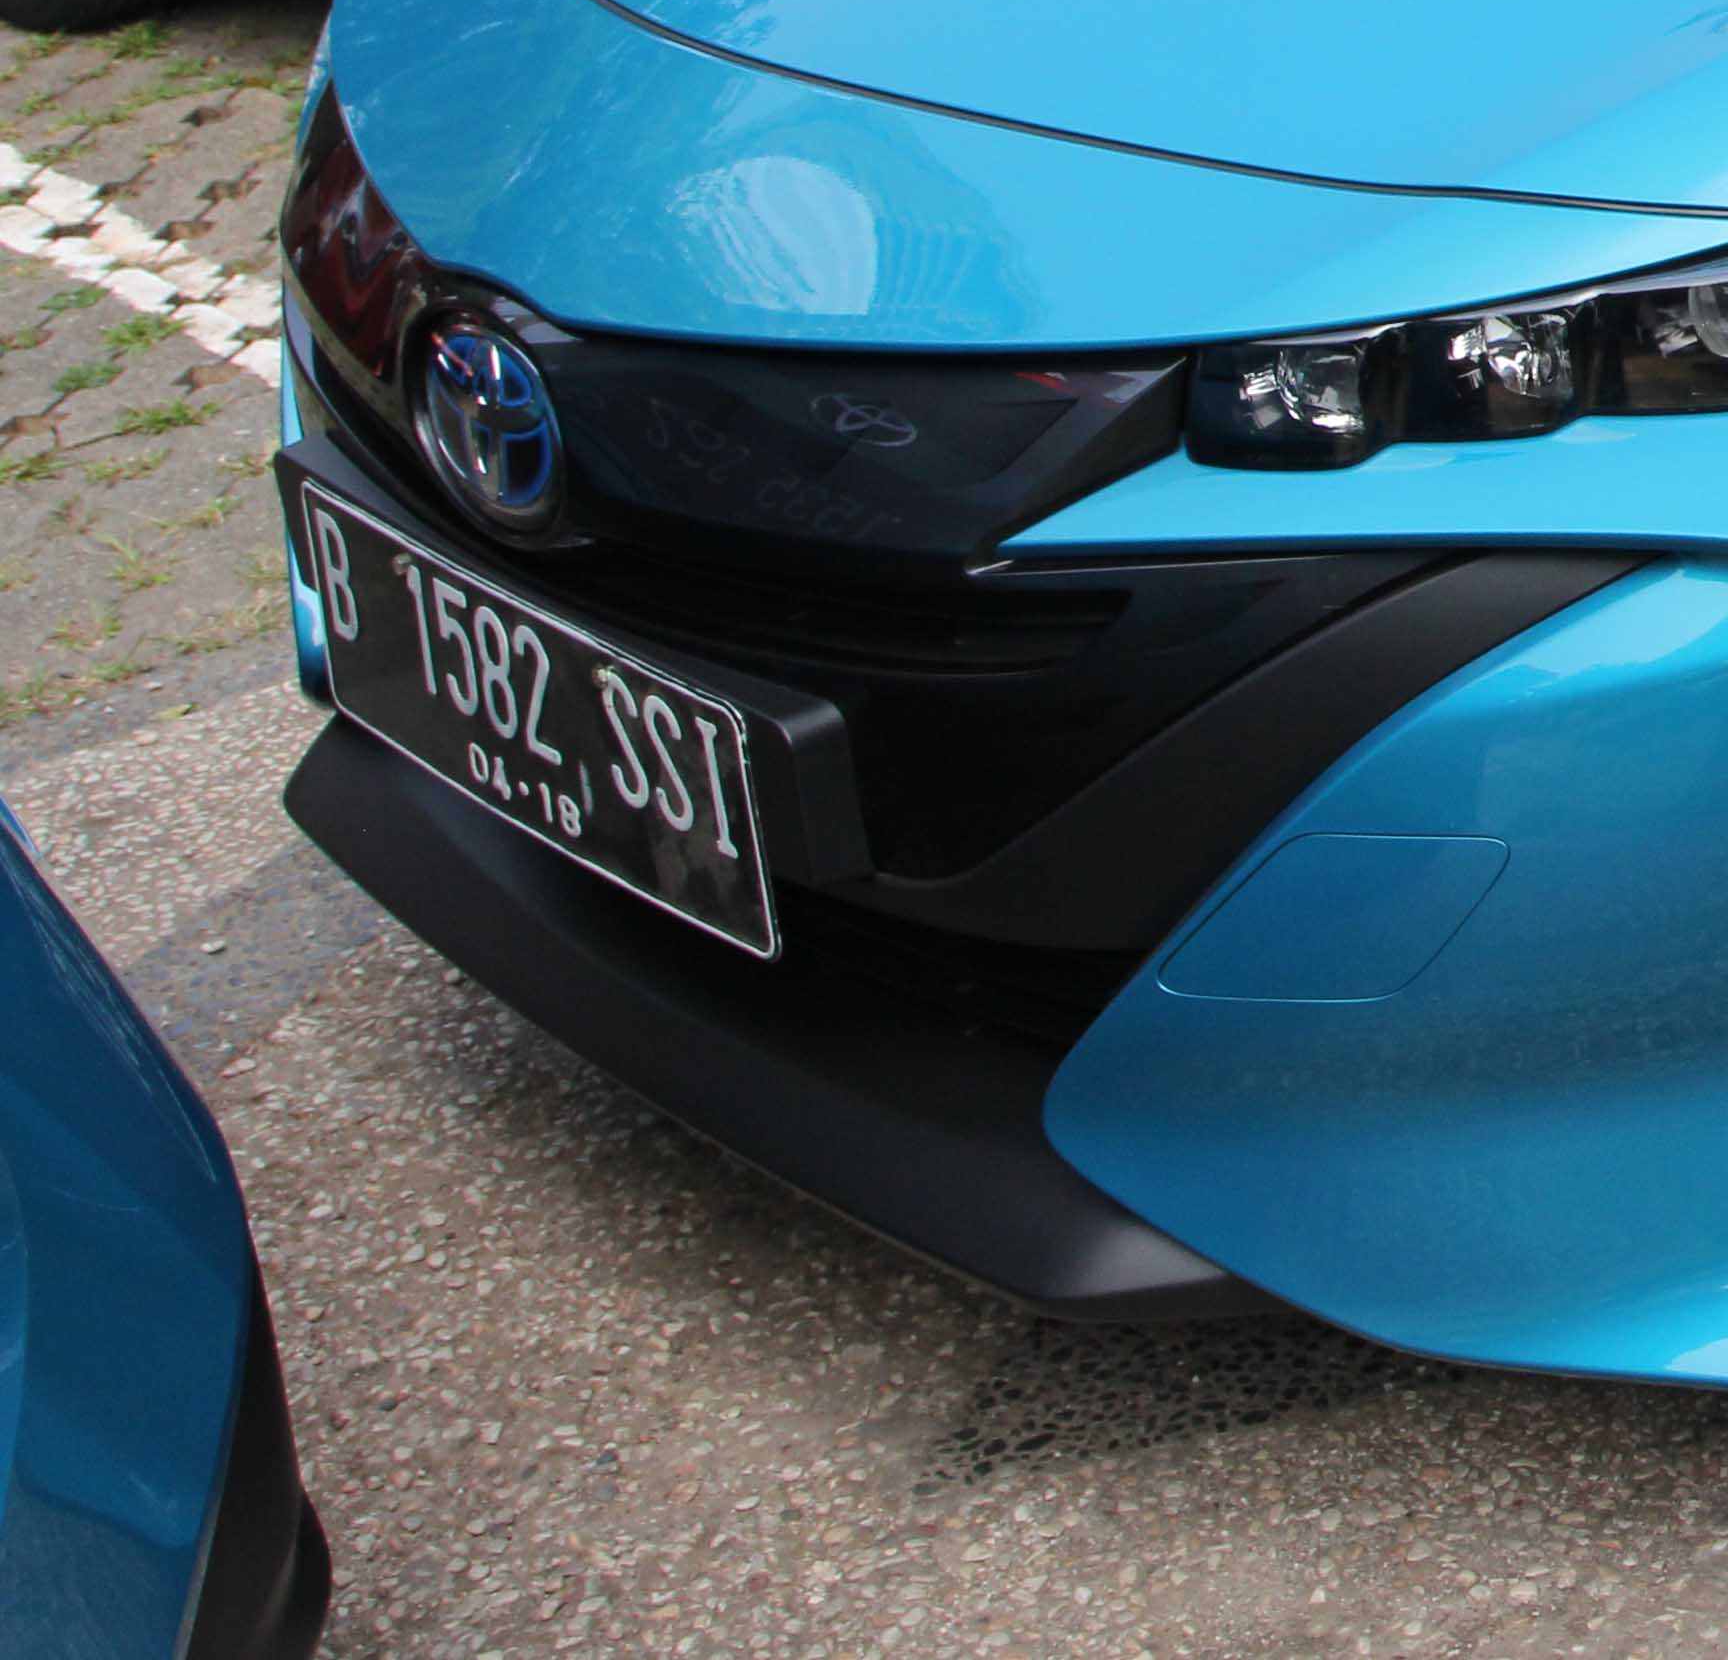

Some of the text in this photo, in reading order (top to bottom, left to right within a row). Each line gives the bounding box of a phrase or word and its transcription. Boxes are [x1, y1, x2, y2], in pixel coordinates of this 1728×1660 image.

[315, 507, 739, 860] B 1582 SSI
